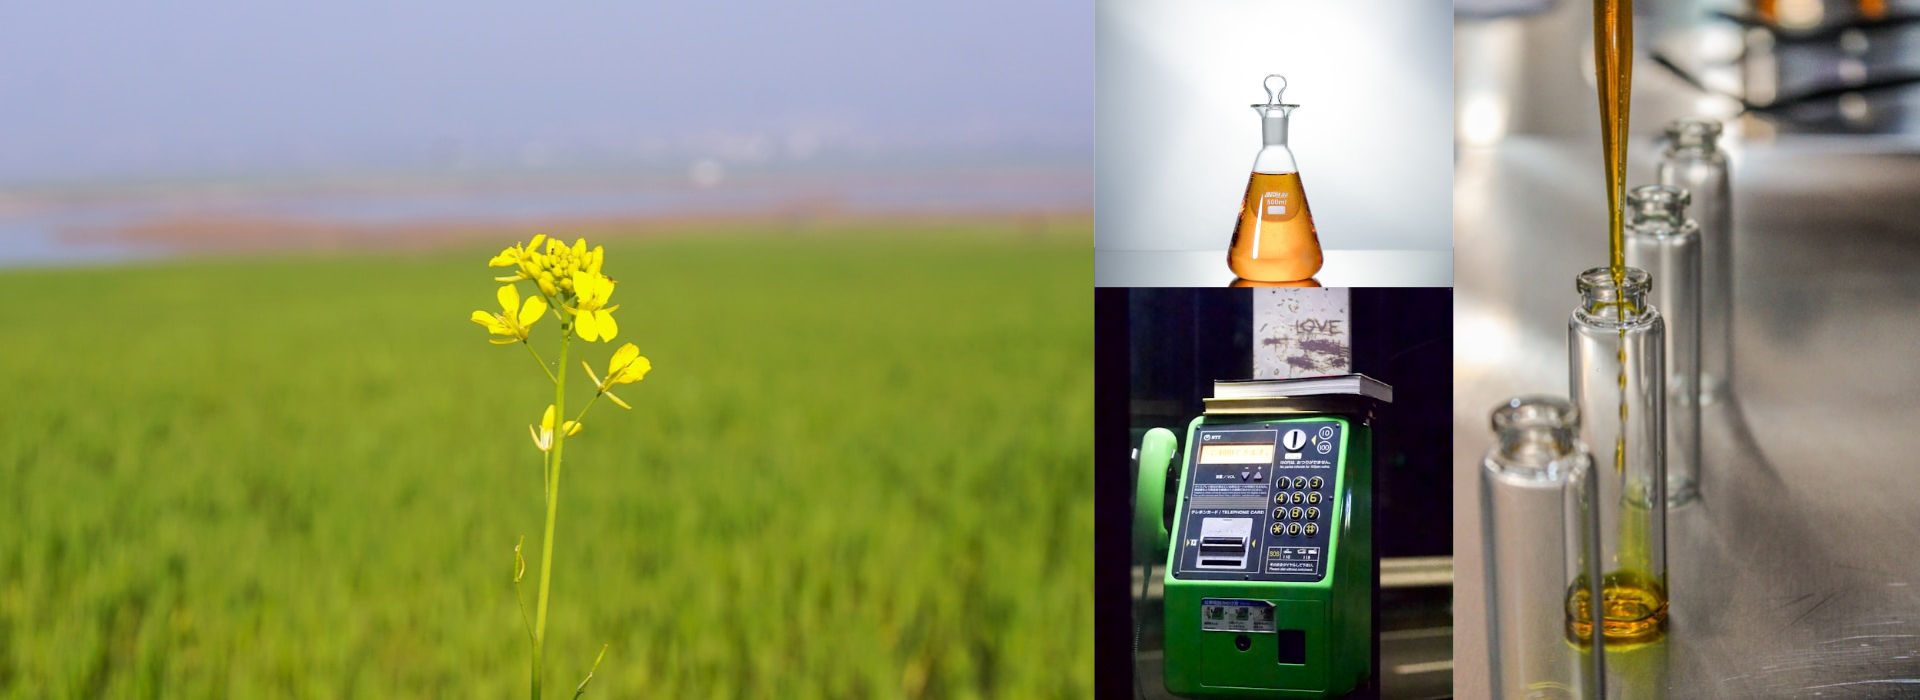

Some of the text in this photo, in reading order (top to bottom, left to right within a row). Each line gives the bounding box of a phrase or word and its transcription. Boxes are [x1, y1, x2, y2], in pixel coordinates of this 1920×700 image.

[1296, 318, 1343, 334] LOVE
[1296, 477, 1302, 487] 2
[1312, 477, 1318, 487] 3
[1277, 493, 1317, 503] 4 5 6
[1276, 509, 1315, 518] 7 8 9
[1290, 524, 1298, 534] 0
